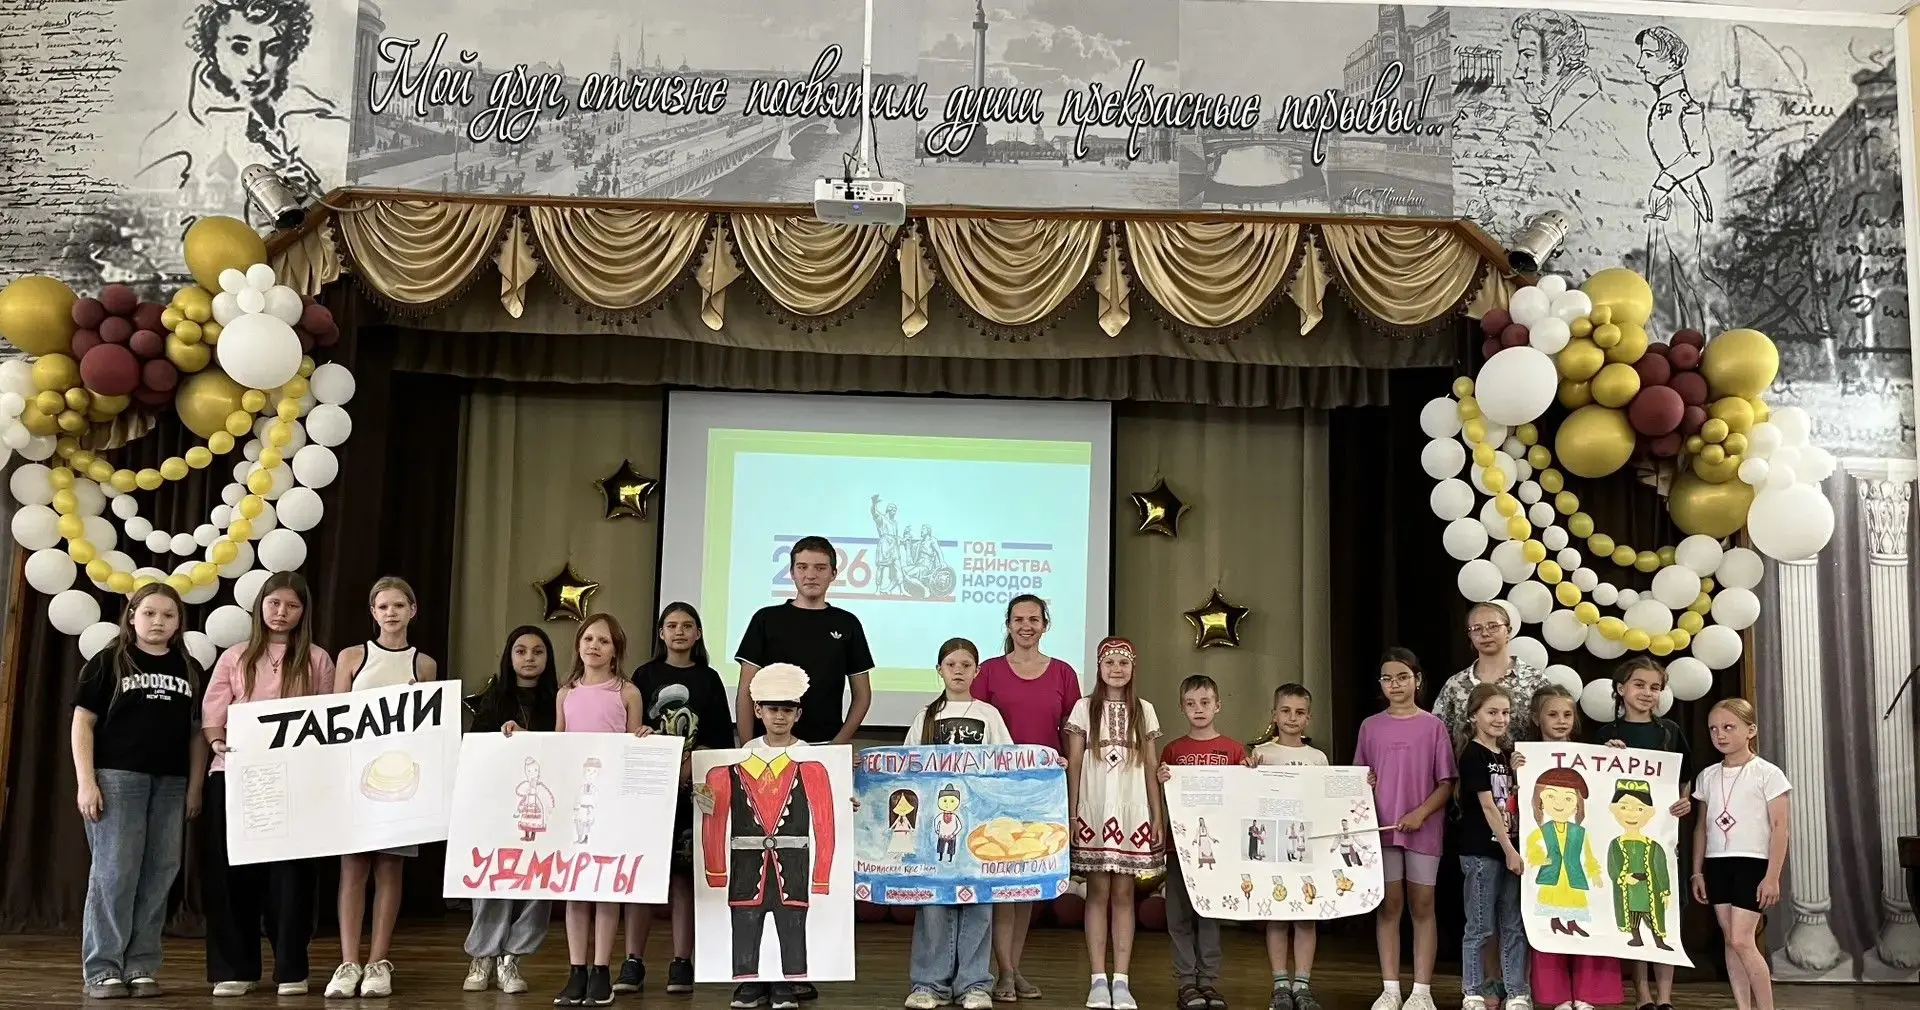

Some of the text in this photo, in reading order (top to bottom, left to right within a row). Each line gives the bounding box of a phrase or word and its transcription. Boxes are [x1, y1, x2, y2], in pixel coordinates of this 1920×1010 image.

[369, 32, 477, 117] Мой
[467, 63, 570, 143] друг,
[578, 72, 729, 115] отчизне
[743, 43, 929, 121] посвятим
[925, 81, 1044, 158] души
[1059, 59, 1260, 161] прекрасные
[963, 541, 996, 557] ГОД
[963, 557, 1052, 573] ЕДИНСТВА
[772, 545, 872, 588] 226
[962, 573, 1043, 590] НАРОДОВ
[257, 687, 443, 750] ТАБАНИ
[1551, 752, 1663, 777] ТАТАРЫ
[462, 846, 645, 895] УДМУРТЫ
